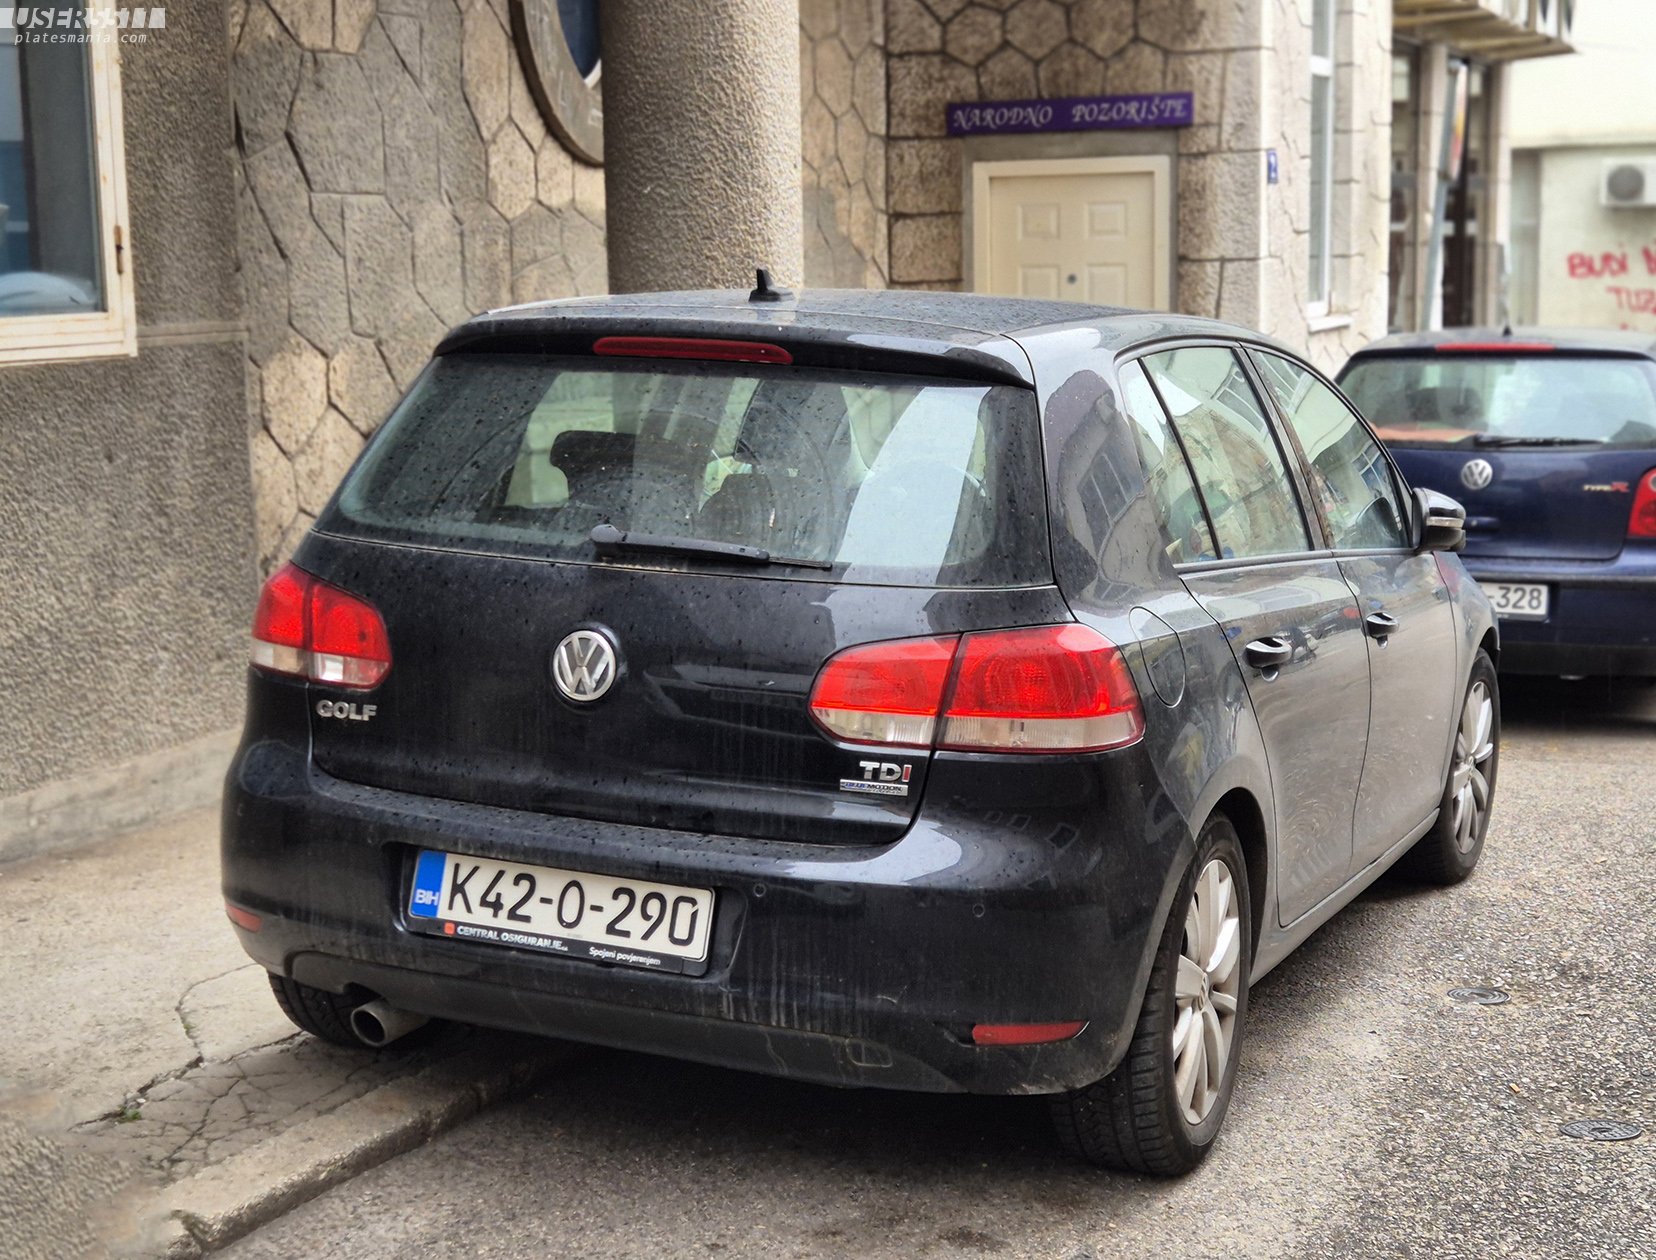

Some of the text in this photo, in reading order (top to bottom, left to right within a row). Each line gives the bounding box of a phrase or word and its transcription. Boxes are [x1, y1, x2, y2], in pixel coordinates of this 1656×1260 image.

[953, 98, 1187, 130] NARODNO POZORIŠTE
[1487, 586, 1543, 611] -328
[316, 699, 377, 721] GOLF
[859, 761, 912, 782] TDI
[415, 888, 440, 906] BIH
[457, 925, 562, 951] CENTRAL OSIGURANJE
[589, 946, 616, 959] Spojeni
